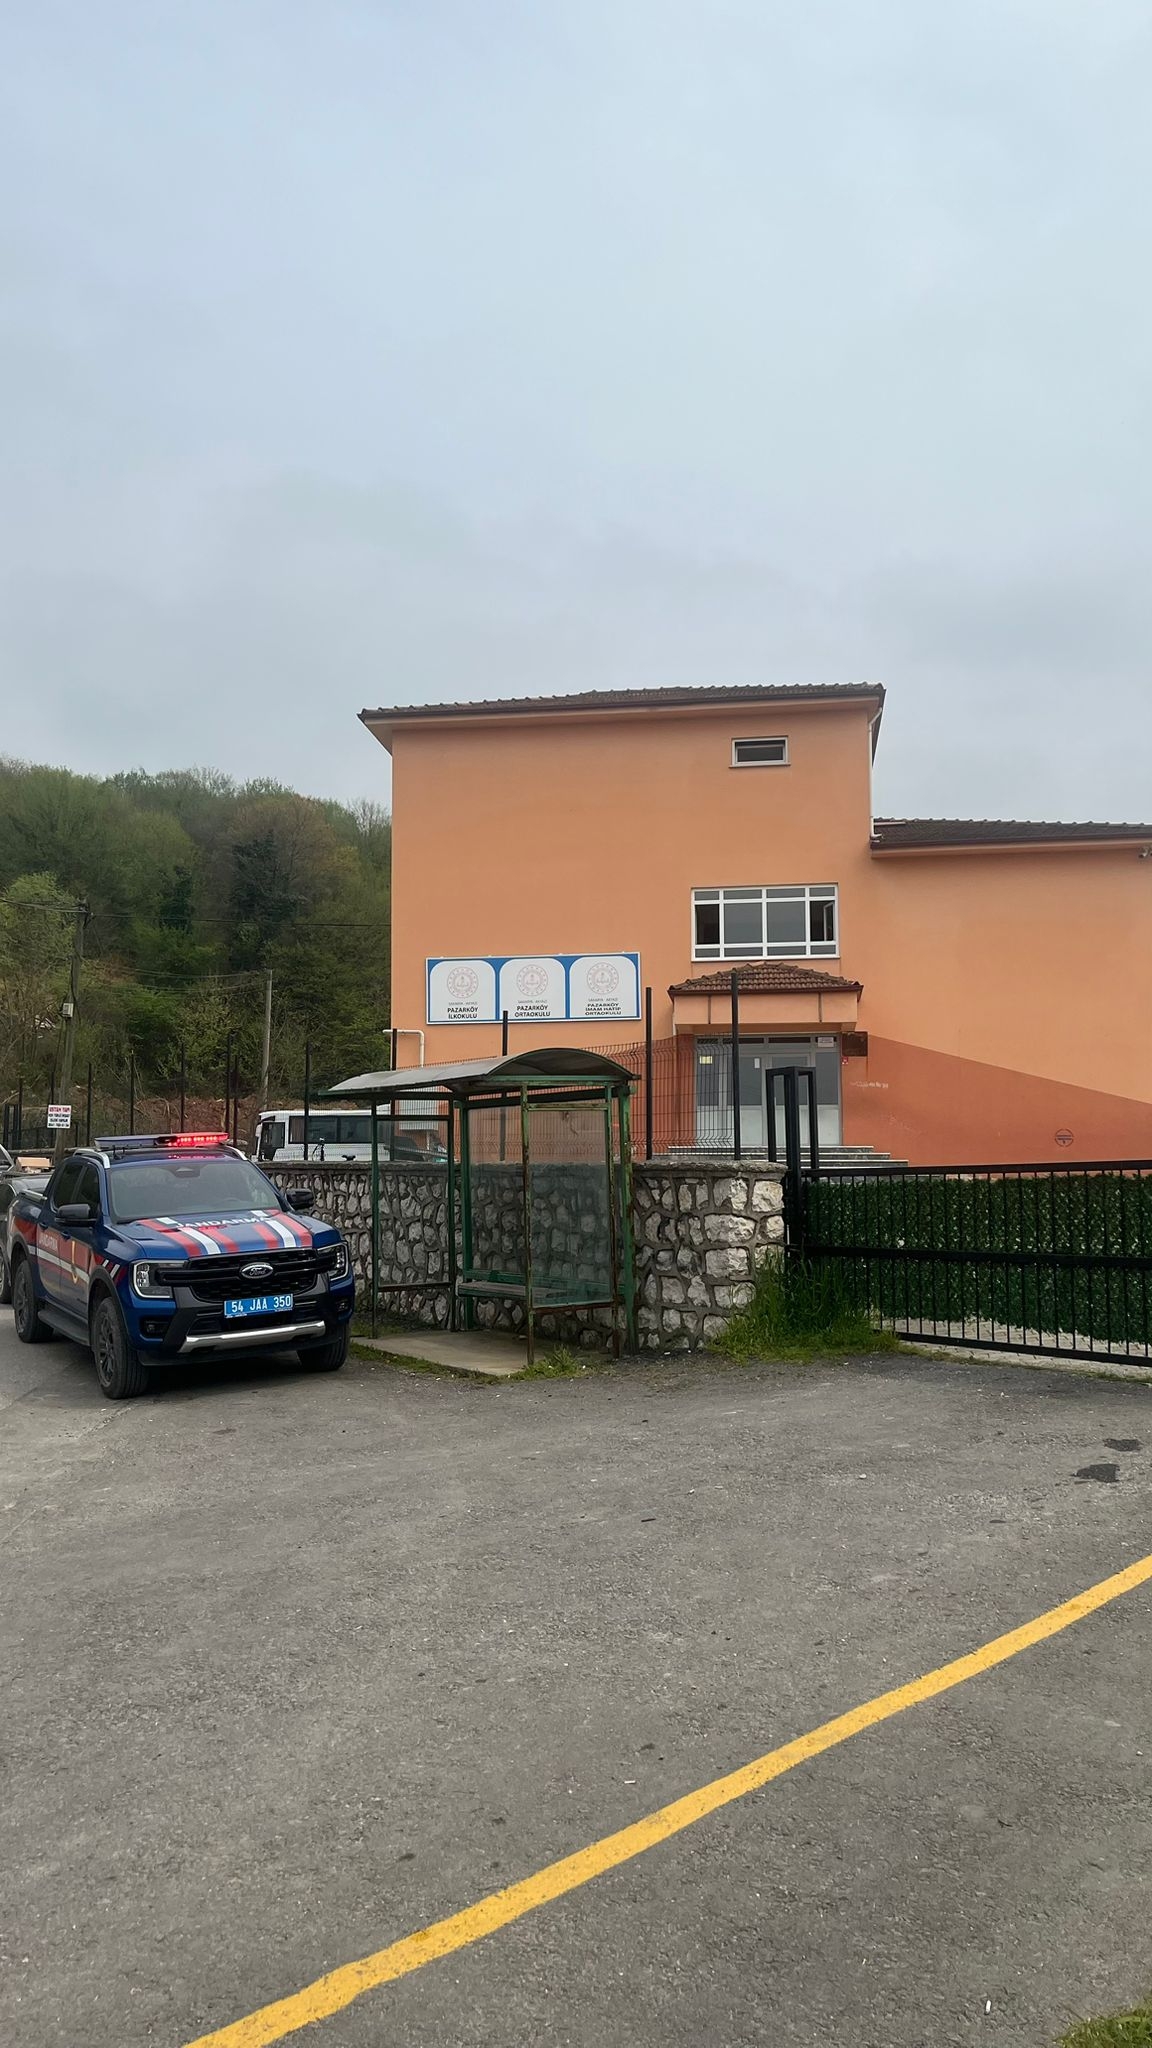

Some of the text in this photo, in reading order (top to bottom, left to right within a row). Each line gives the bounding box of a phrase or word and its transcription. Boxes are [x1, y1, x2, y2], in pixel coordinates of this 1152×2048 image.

[176, 1216, 270, 1228] JANDARMA
[231, 1295, 291, 1313] 54 JAA 350
